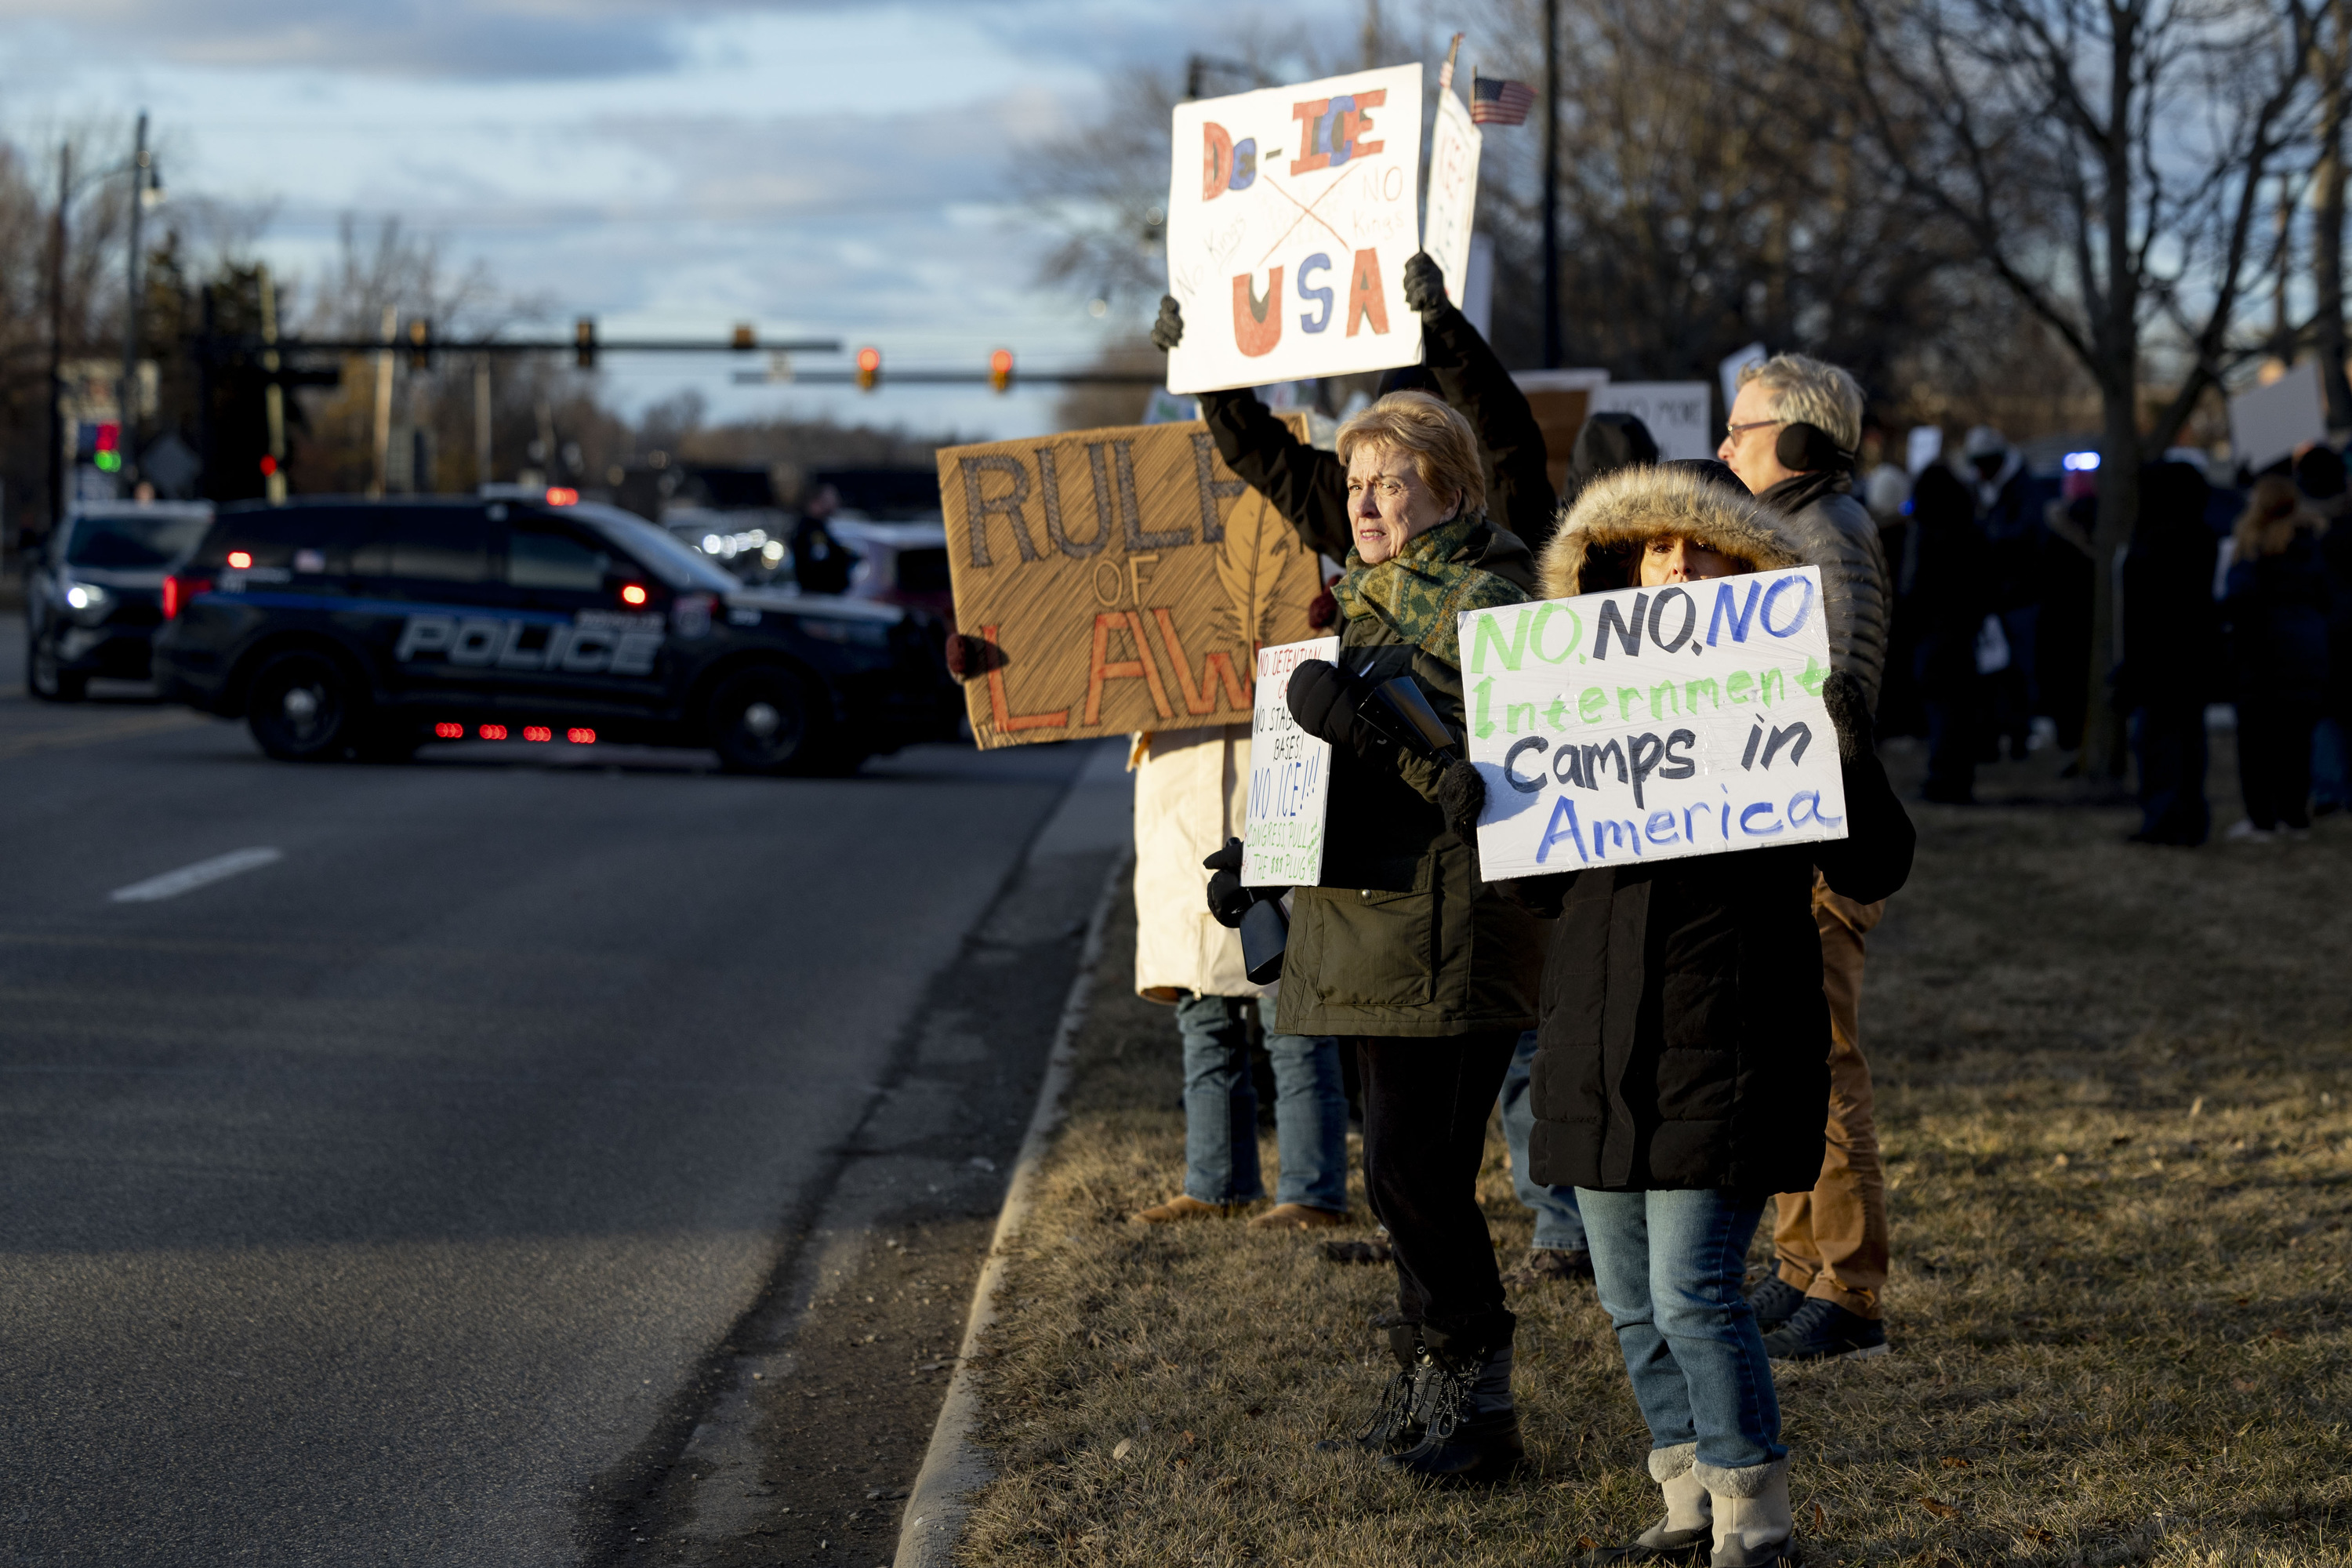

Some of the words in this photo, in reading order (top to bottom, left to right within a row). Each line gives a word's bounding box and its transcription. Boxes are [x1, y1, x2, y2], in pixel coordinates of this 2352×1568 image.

[1363, 165, 1403, 201] NO
[1353, 209, 1404, 241] Kings
[1232, 247, 1390, 358] USA
[1093, 554, 1160, 607] OF
[1706, 575, 1813, 648] NO
[394, 613, 665, 675] POLICE
[980, 608, 1262, 733] LAW
[1258, 651, 1269, 677] NO
[1254, 705, 1265, 735] NO
[1273, 730, 1305, 762] BASES!
[1740, 713, 1813, 771] in
[1250, 767, 1271, 820] NO
[1276, 746, 1321, 818] ICE!!!
[1288, 821, 1307, 848] PULL
[1536, 783, 1843, 864] America
[1254, 853, 1269, 880] THE
[1284, 853, 1305, 880] PLUG
